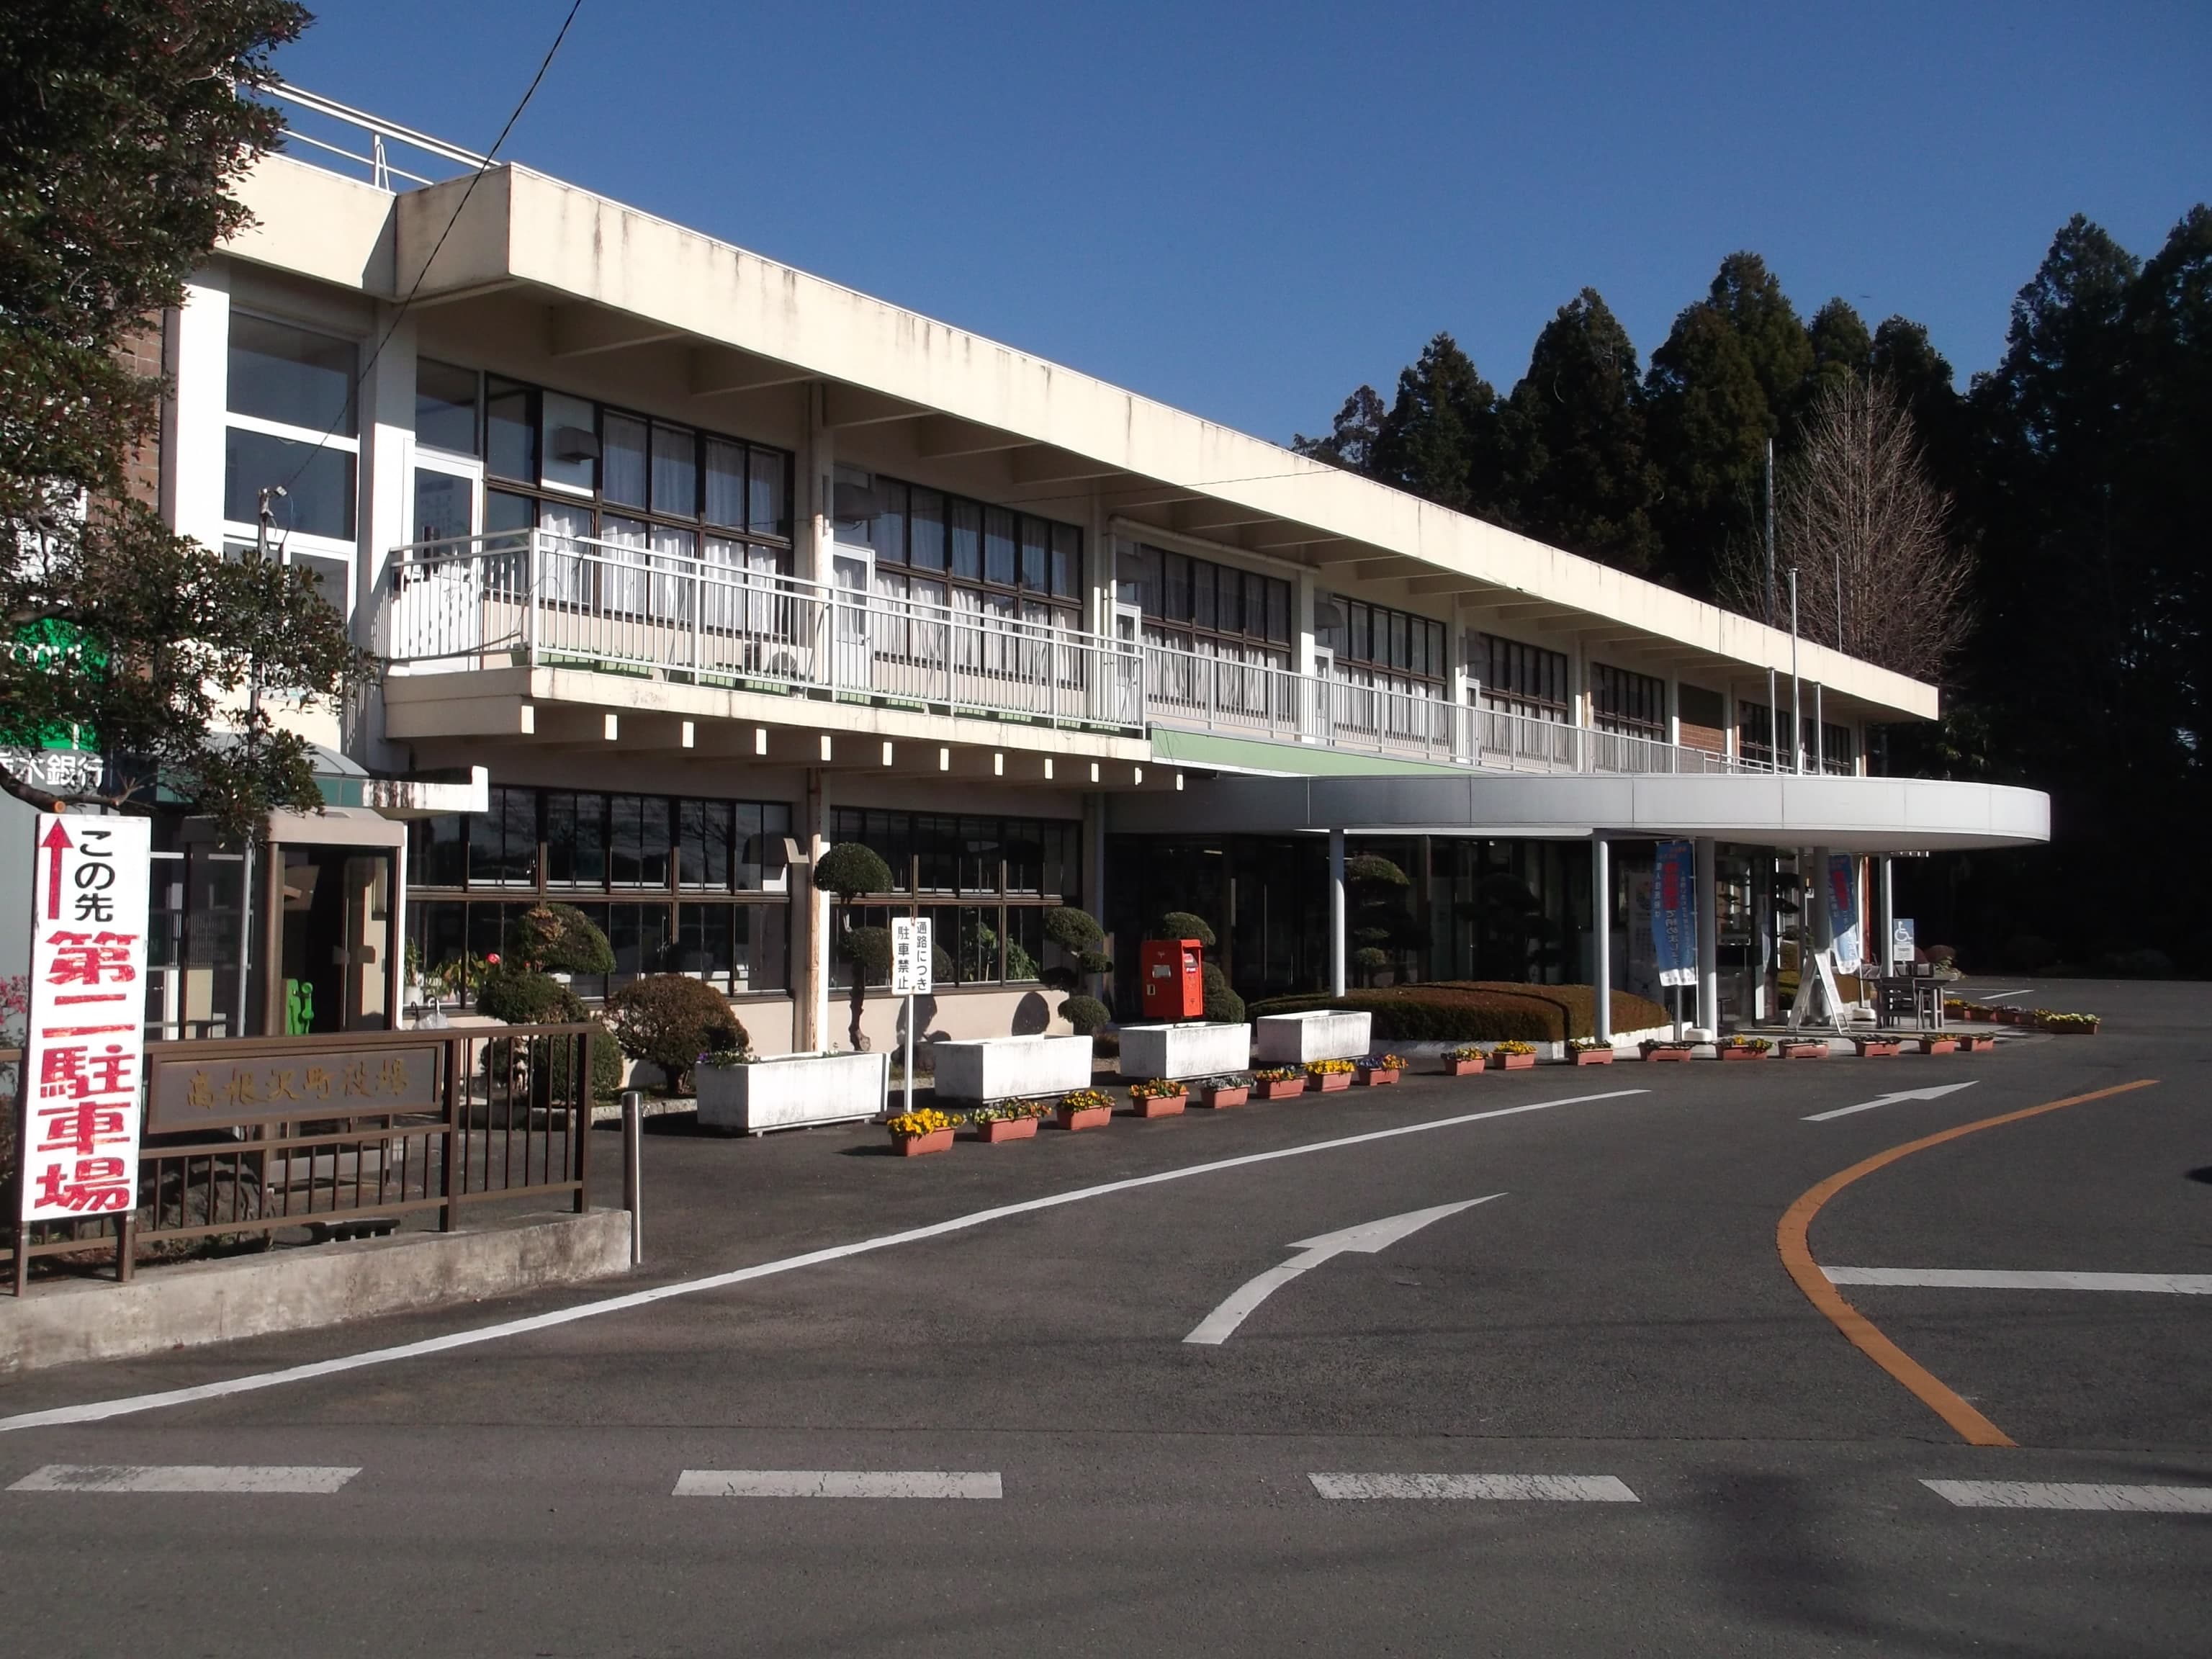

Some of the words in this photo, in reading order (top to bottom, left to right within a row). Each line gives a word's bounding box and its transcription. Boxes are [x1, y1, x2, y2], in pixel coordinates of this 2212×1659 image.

[74, 830, 116, 922] この先
[897, 926, 910, 990] 駐車禁止
[916, 921, 927, 991] 通路につき
[34, 930, 140, 1213] 第二駐車場
